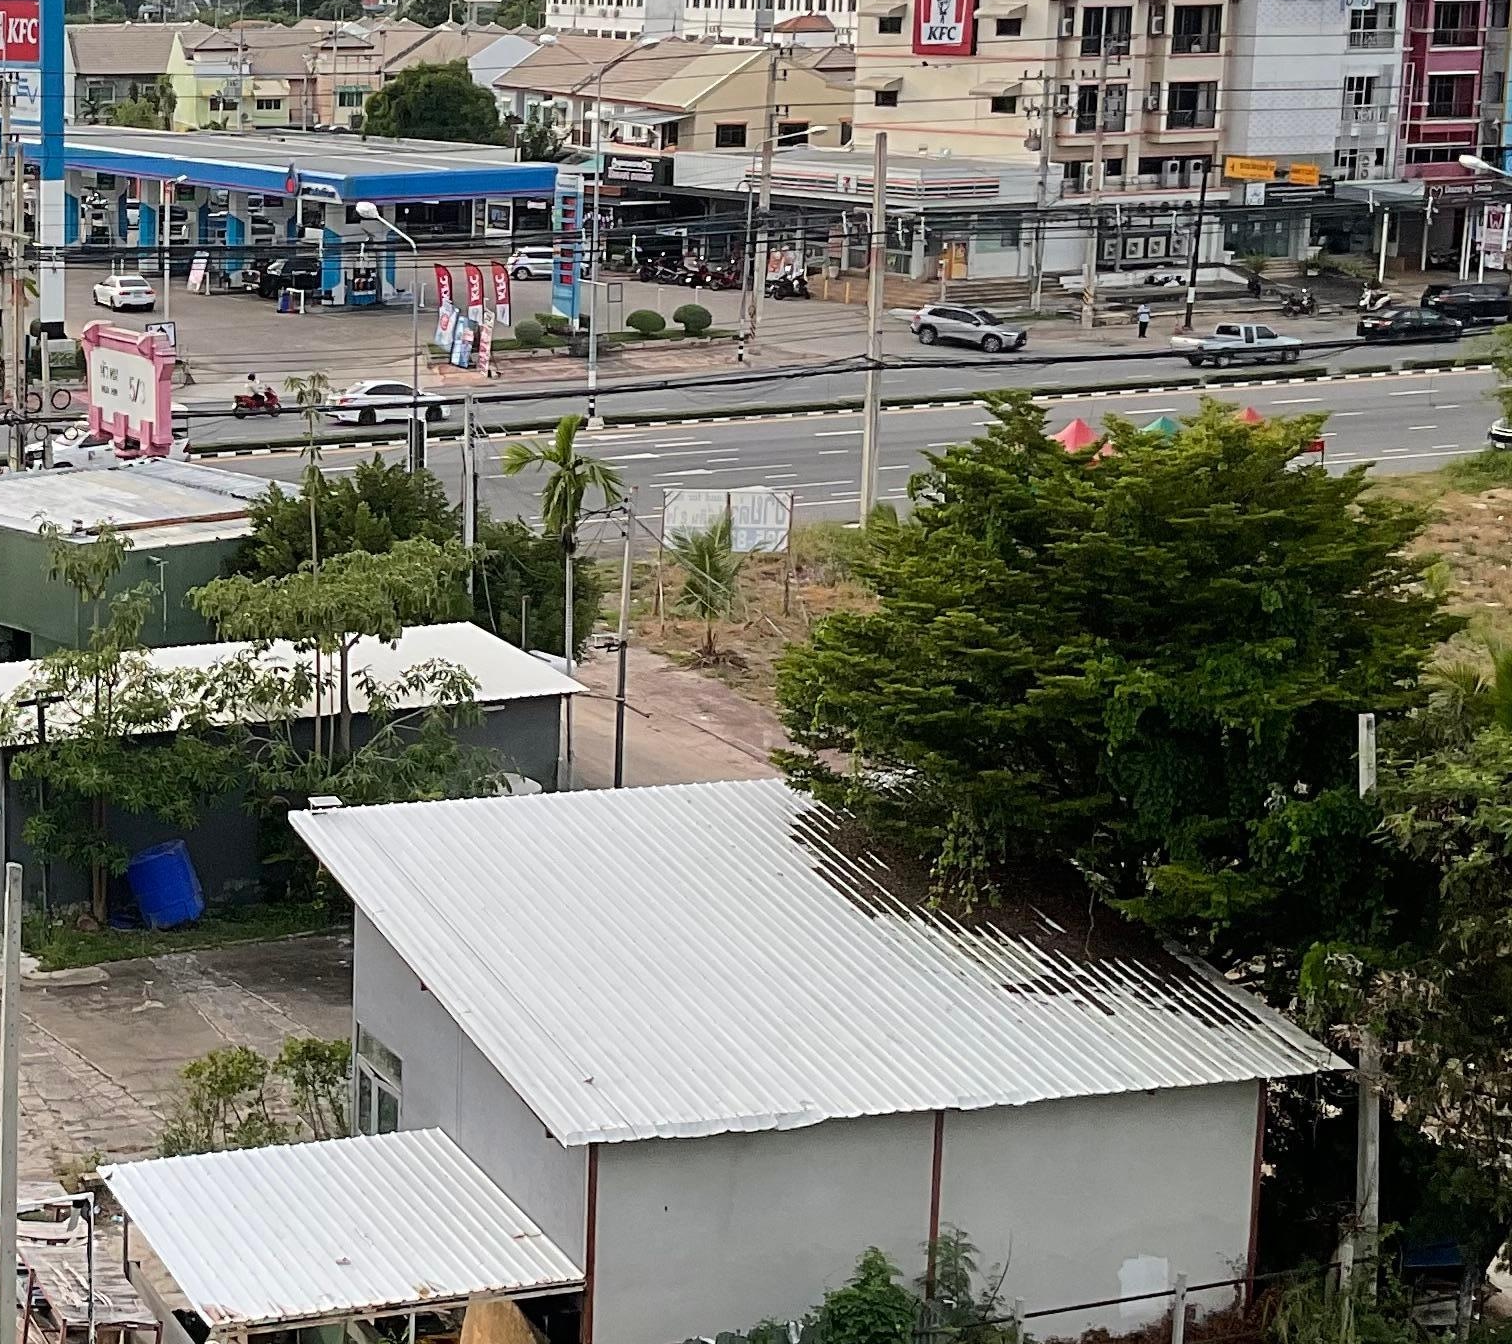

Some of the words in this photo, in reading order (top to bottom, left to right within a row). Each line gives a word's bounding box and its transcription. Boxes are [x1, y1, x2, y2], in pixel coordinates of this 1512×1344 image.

[7, 17, 39, 45] KFC
[927, 26, 957, 41] KFC
[469, 274, 480, 302] KFC
[494, 272, 507, 301] KFC
